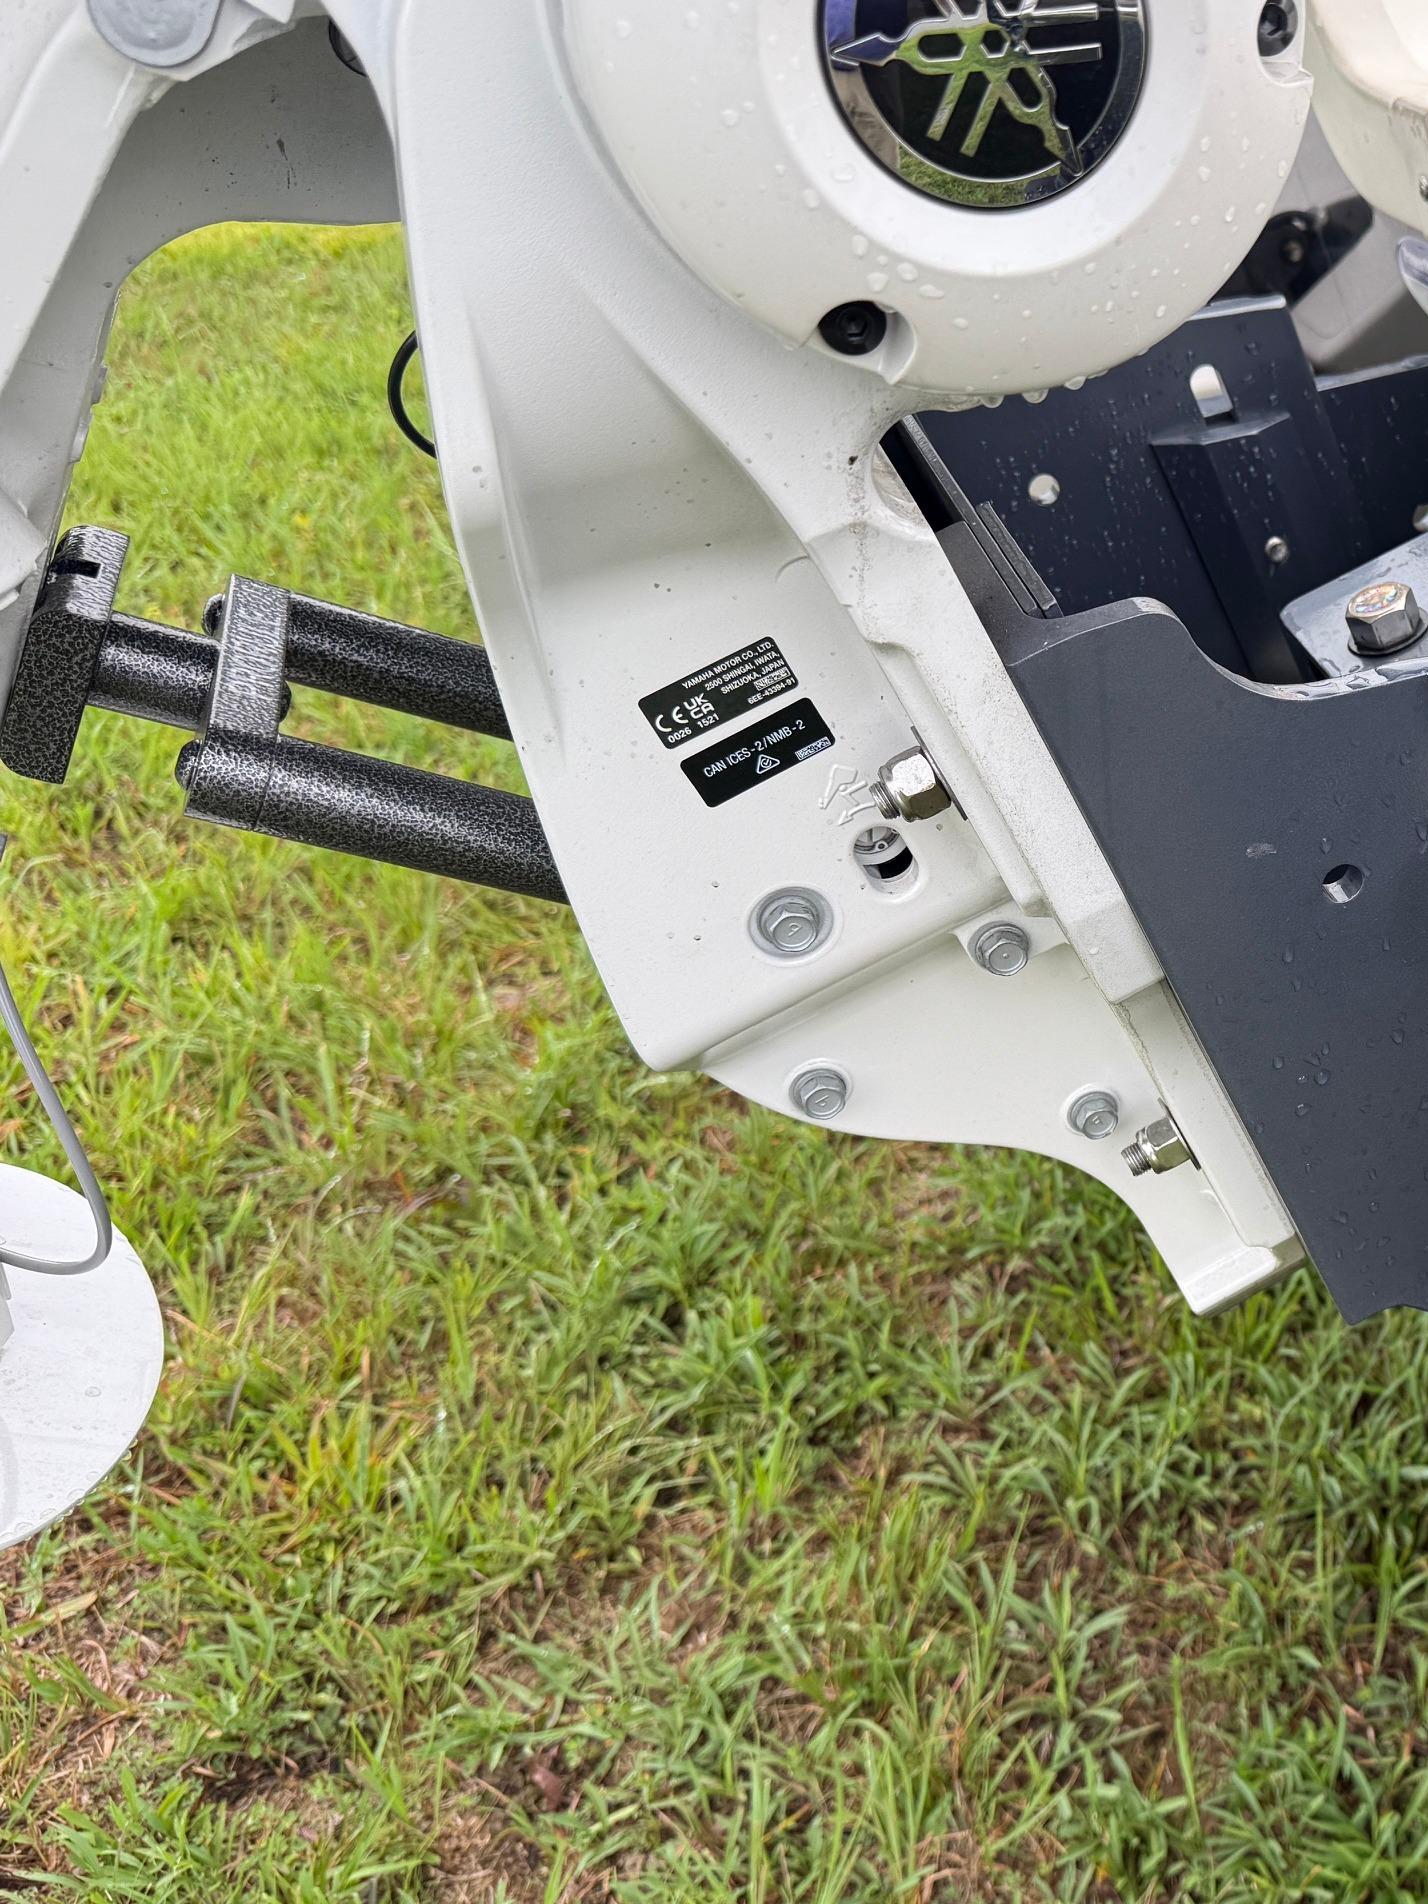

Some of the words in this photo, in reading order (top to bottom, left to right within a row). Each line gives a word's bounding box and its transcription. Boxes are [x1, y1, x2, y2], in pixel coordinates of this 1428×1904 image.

[682, 669, 715, 690] YAMAHA
[715, 656, 742, 675] MOTOR
[742, 649, 759, 662] CO.,
[758, 641, 774, 653] LTD.
[704, 677, 723, 691] 2500
[723, 663, 756, 683] SHINGAI,
[755, 651, 780, 667] IWATA,
[720, 672, 761, 695] SHIZUOKA,
[760, 658, 785, 676] JAPAN
[747, 677, 796, 705] 6EE-43394-91
[696, 713, 720, 729] 1521
[667, 727, 692, 744] 0026
[703, 761, 728, 779] CAN
